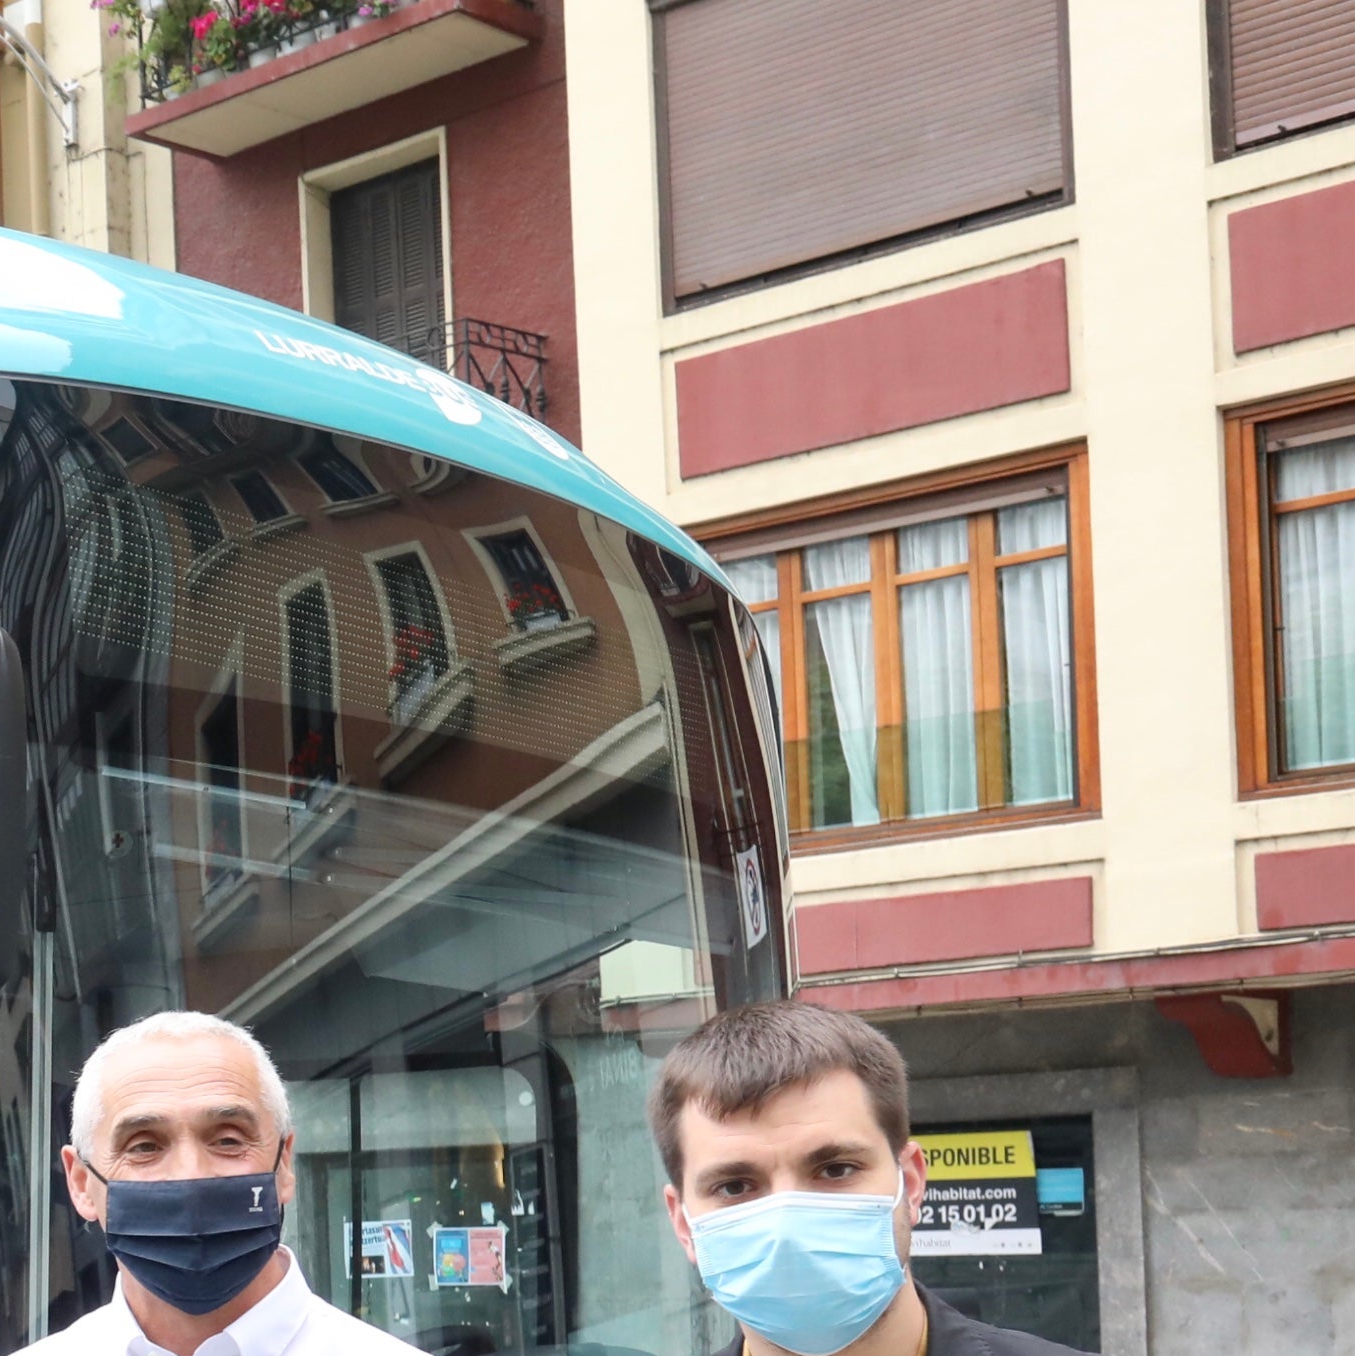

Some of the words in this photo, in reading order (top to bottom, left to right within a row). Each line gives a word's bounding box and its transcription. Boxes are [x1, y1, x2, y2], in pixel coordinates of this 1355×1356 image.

[938, 1204, 959, 1224] 15
[963, 1203, 985, 1223] 01
[991, 1203, 1017, 1222] 02
